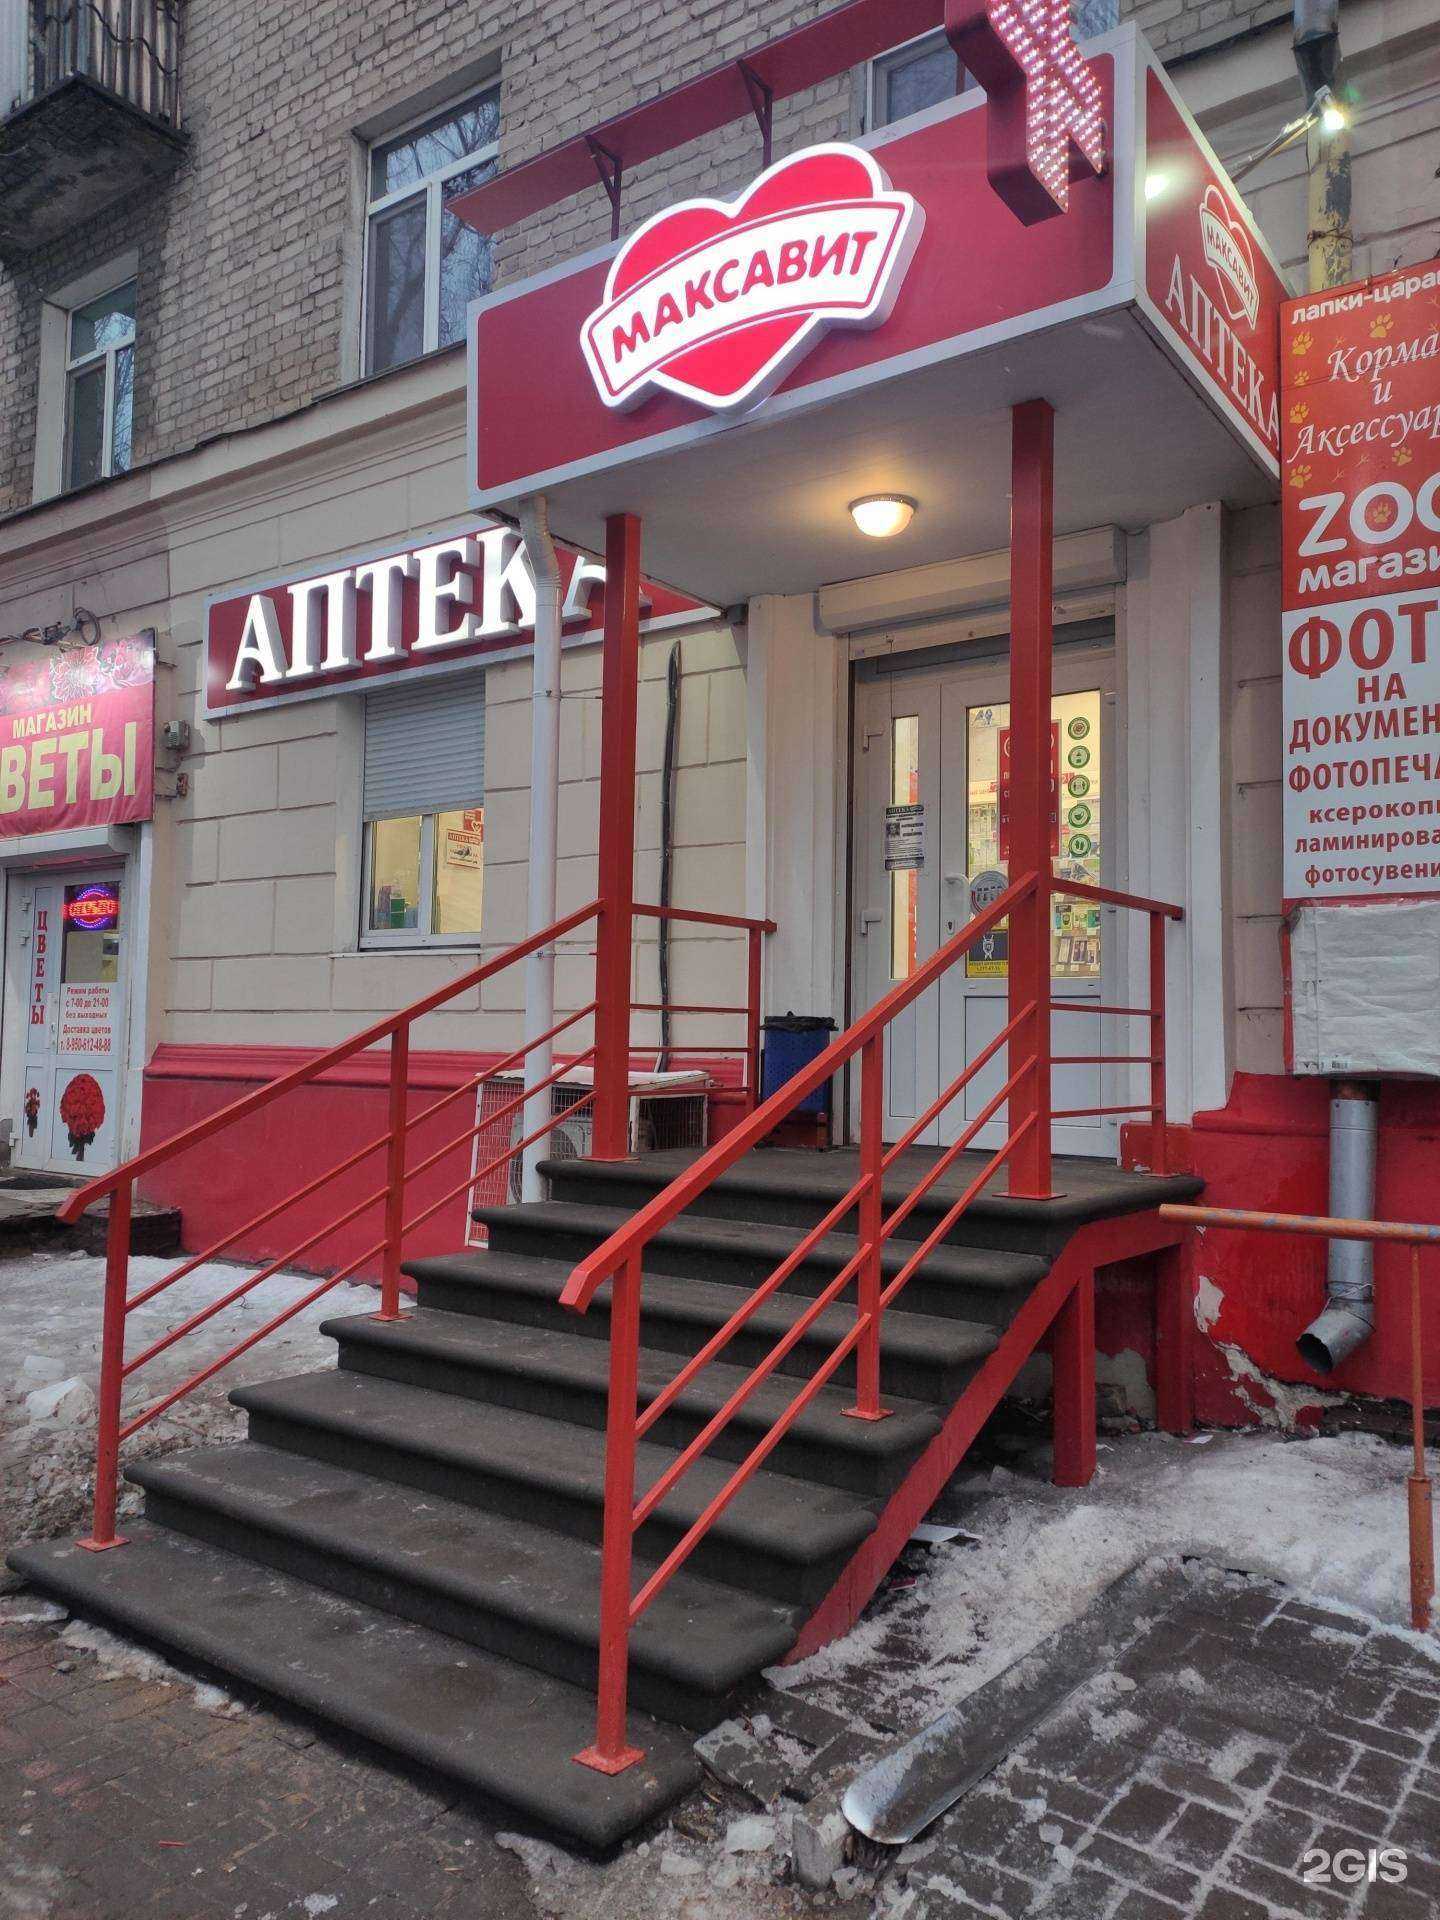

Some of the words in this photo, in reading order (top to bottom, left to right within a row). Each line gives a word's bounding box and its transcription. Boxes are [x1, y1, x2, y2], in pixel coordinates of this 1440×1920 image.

[611, 231, 878, 363] МАКСАВИТ
[1291, 270, 1440, 325] лапки-цара
[1328, 331, 1440, 383] Корма
[1372, 381, 1393, 405] и
[1288, 600, 1438, 680] ФОТ
[1357, 672, 1407, 704] НА
[12, 703, 93, 739] МАГАЗИН
[1289, 704, 1440, 755] ДОКУМЕН
[1288, 754, 1440, 793] ФОТОПЕЧ
[1309, 800, 1440, 825] ксерокоп
[31, 911, 48, 1025] ЦВЕТЫ
[63, 1024, 90, 1034] Доставка
